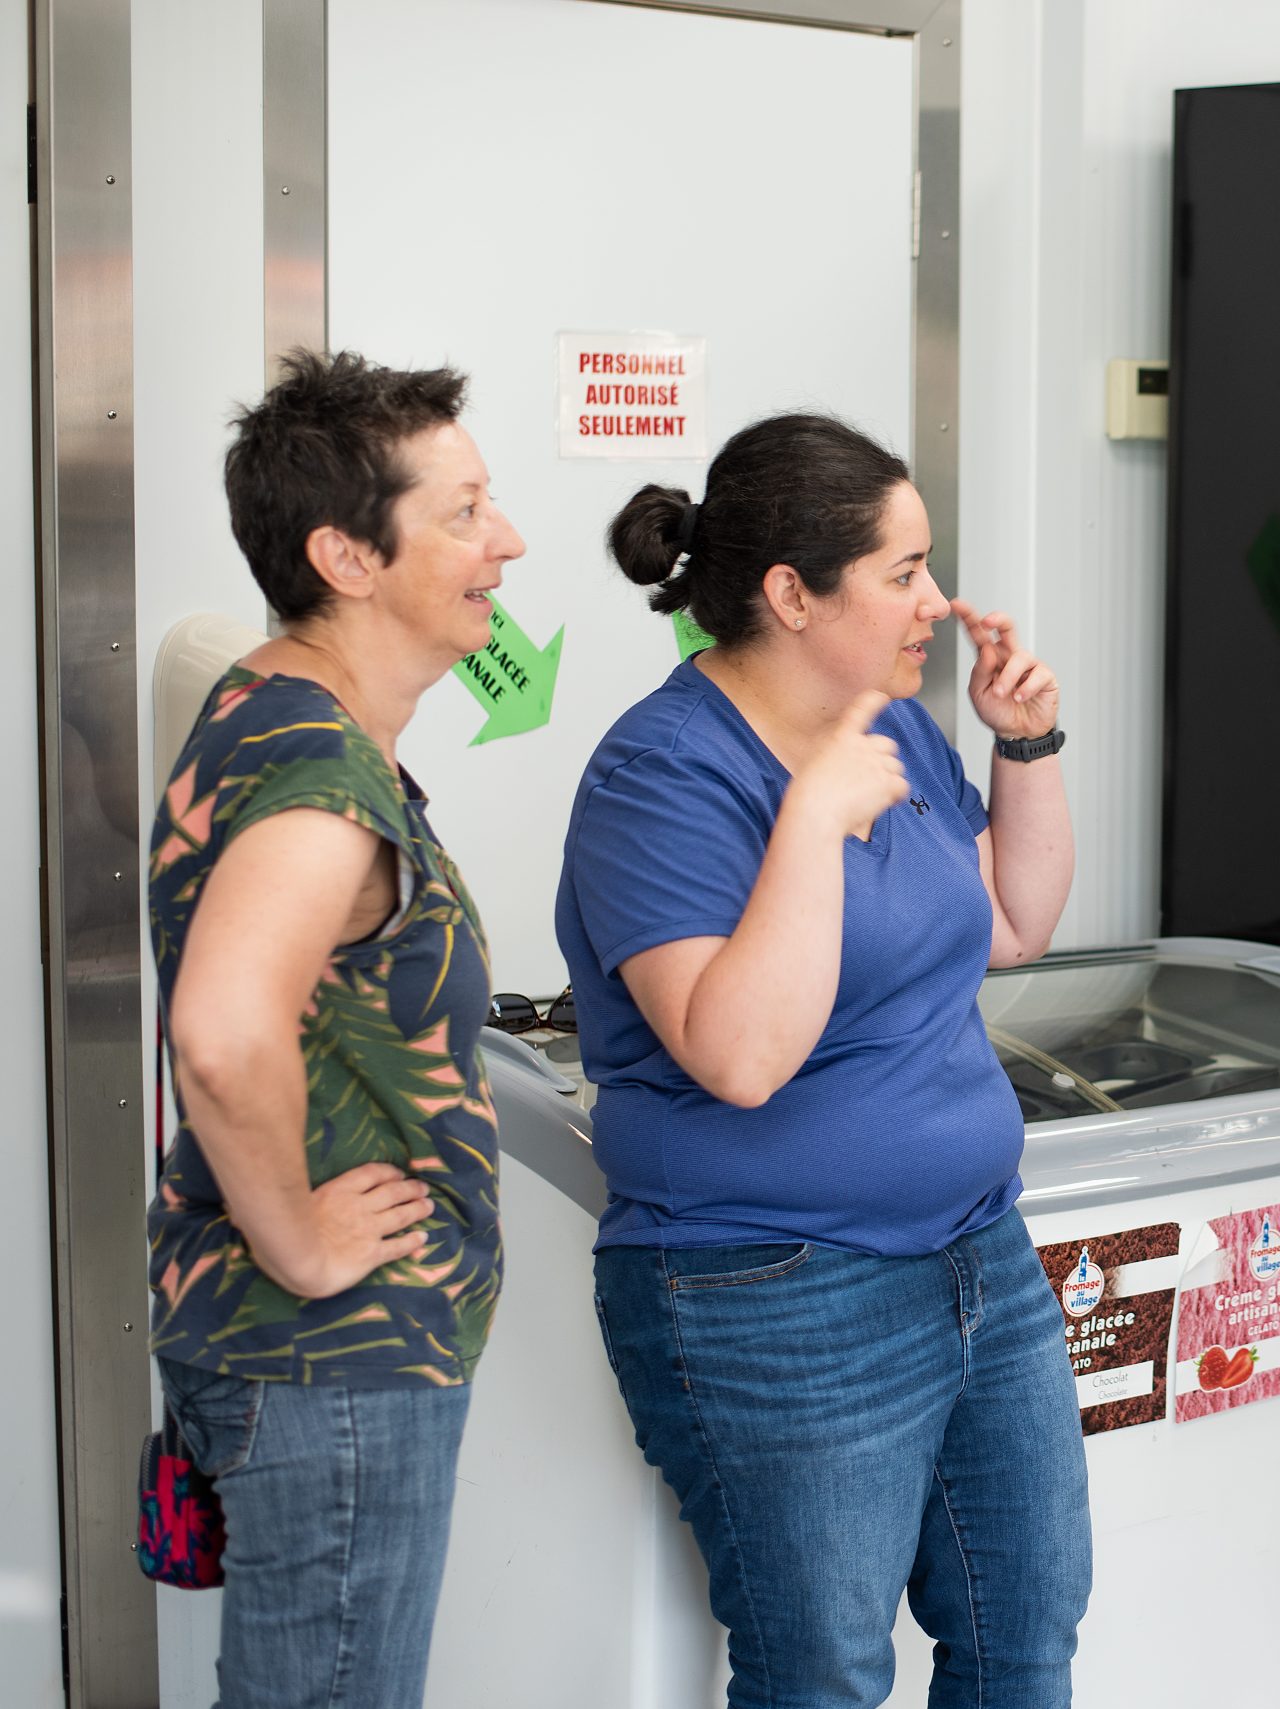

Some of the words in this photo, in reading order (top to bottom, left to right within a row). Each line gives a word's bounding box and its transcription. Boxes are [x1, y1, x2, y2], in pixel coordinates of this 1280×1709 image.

[579, 353, 686, 375] PERSONNEL
[585, 381, 679, 406] AUTORISÉ
[578, 415, 687, 436] SEULEMENT
[1250, 1245, 1280, 1258] Fromage
[1256, 1261, 1280, 1273] village
[1064, 1280, 1101, 1293] Fromage
[1070, 1295, 1099, 1308] village
[1214, 1289, 1262, 1311] Crème
[1080, 1310, 1136, 1337] glacée
[1247, 1321, 1280, 1336] GELATO
[1092, 1371, 1129, 1388] Chocolat
